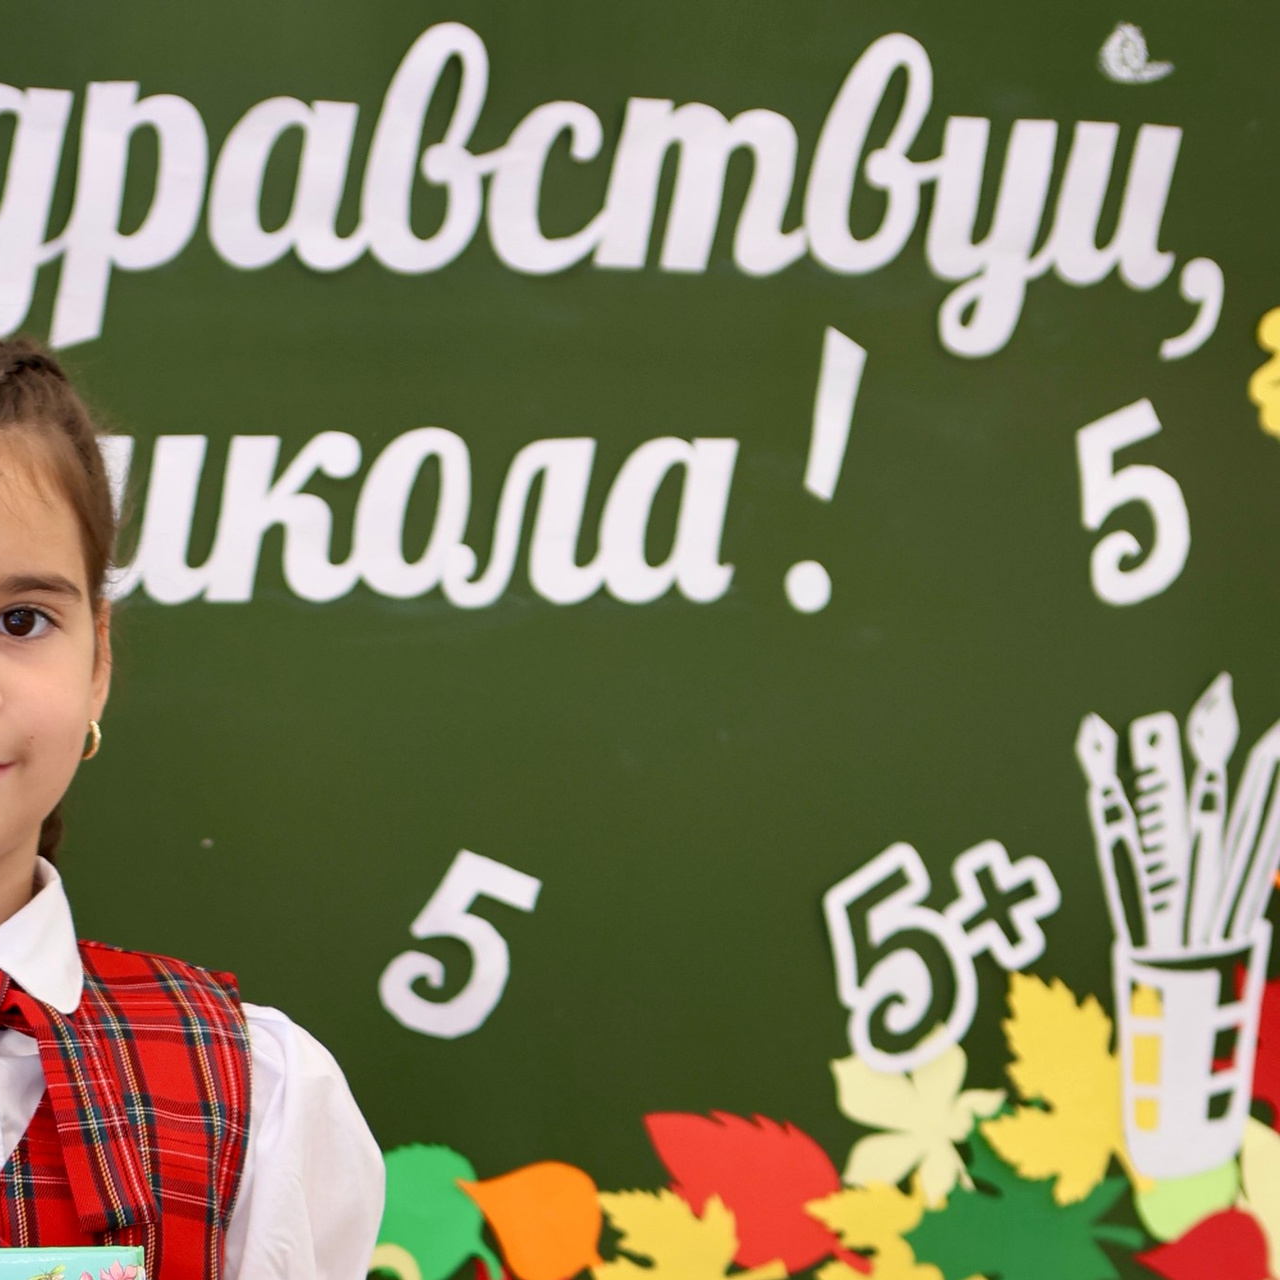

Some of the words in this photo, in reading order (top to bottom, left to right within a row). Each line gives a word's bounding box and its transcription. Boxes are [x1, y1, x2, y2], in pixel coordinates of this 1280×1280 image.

[1077, 399, 1190, 605] 5
[380, 850, 541, 1038] 5
[823, 840, 1061, 1074] 5+
